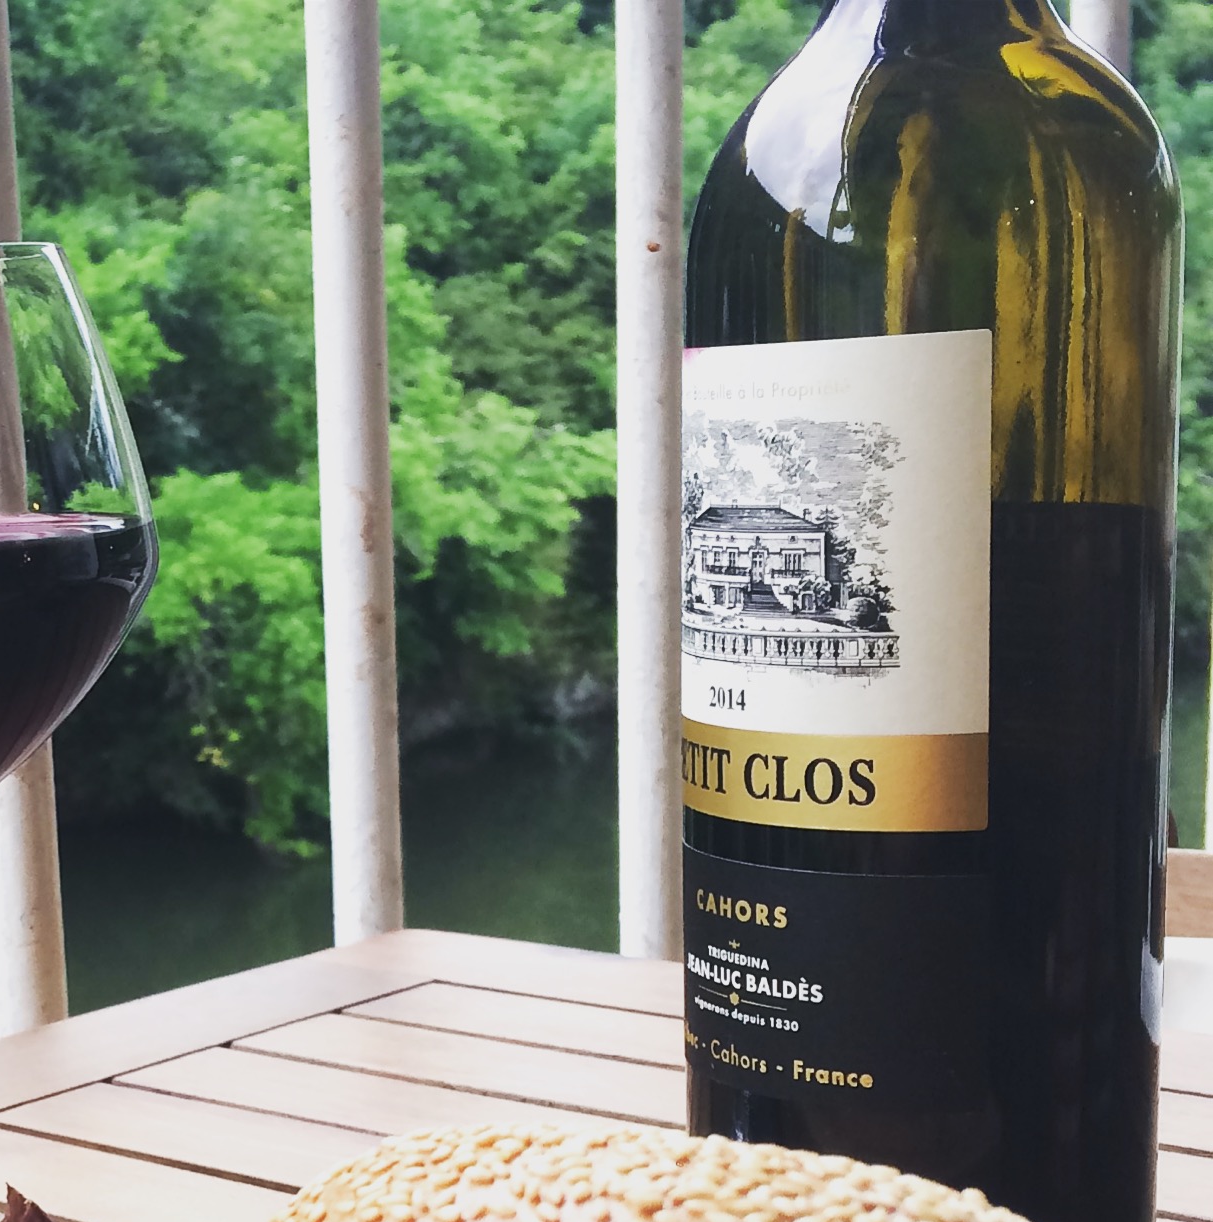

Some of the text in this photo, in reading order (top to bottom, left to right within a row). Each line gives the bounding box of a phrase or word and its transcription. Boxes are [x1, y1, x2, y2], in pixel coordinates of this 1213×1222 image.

[752, 381, 764, 399] la
[709, 686, 746, 711] 2014
[681, 737, 876, 806] ETIT CLOS
[696, 888, 788, 929] CAHORS
[707, 945, 770, 971] TRIGUEDINA
[687, 952, 824, 1004] JEAN-LUC BALDÈS
[694, 995, 799, 1032] vignerons depuis 1830
[711, 1039, 767, 1073] Cahors
[793, 1059, 874, 1088] France
